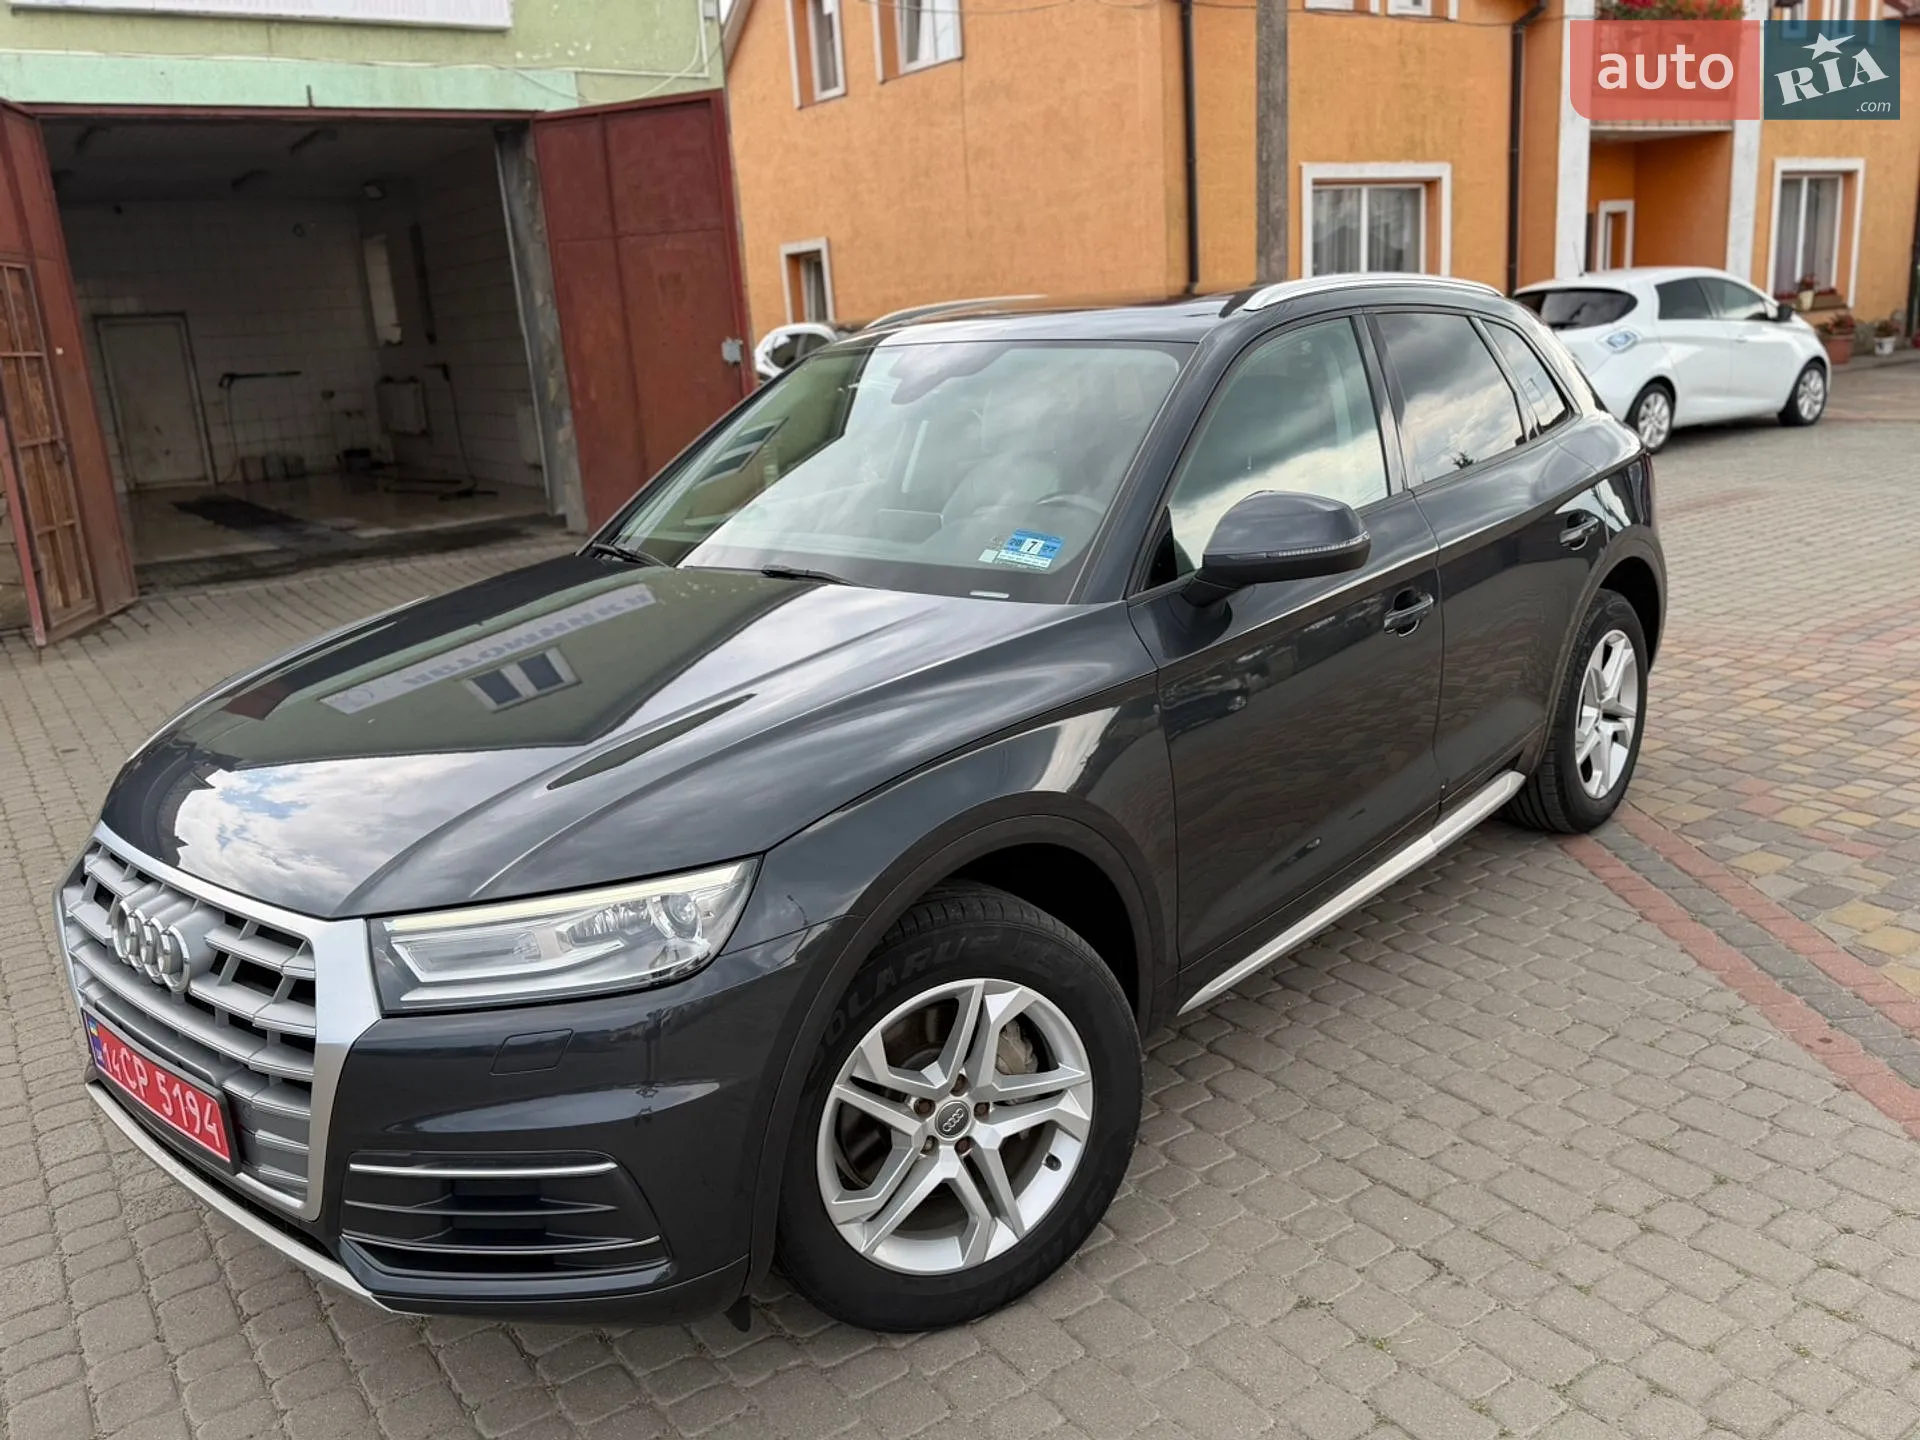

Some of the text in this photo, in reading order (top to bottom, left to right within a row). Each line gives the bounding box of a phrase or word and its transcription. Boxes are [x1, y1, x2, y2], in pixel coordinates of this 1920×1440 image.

[1026, 540, 1038, 552] 7
[102, 1042, 221, 1149] 14CP 5194
